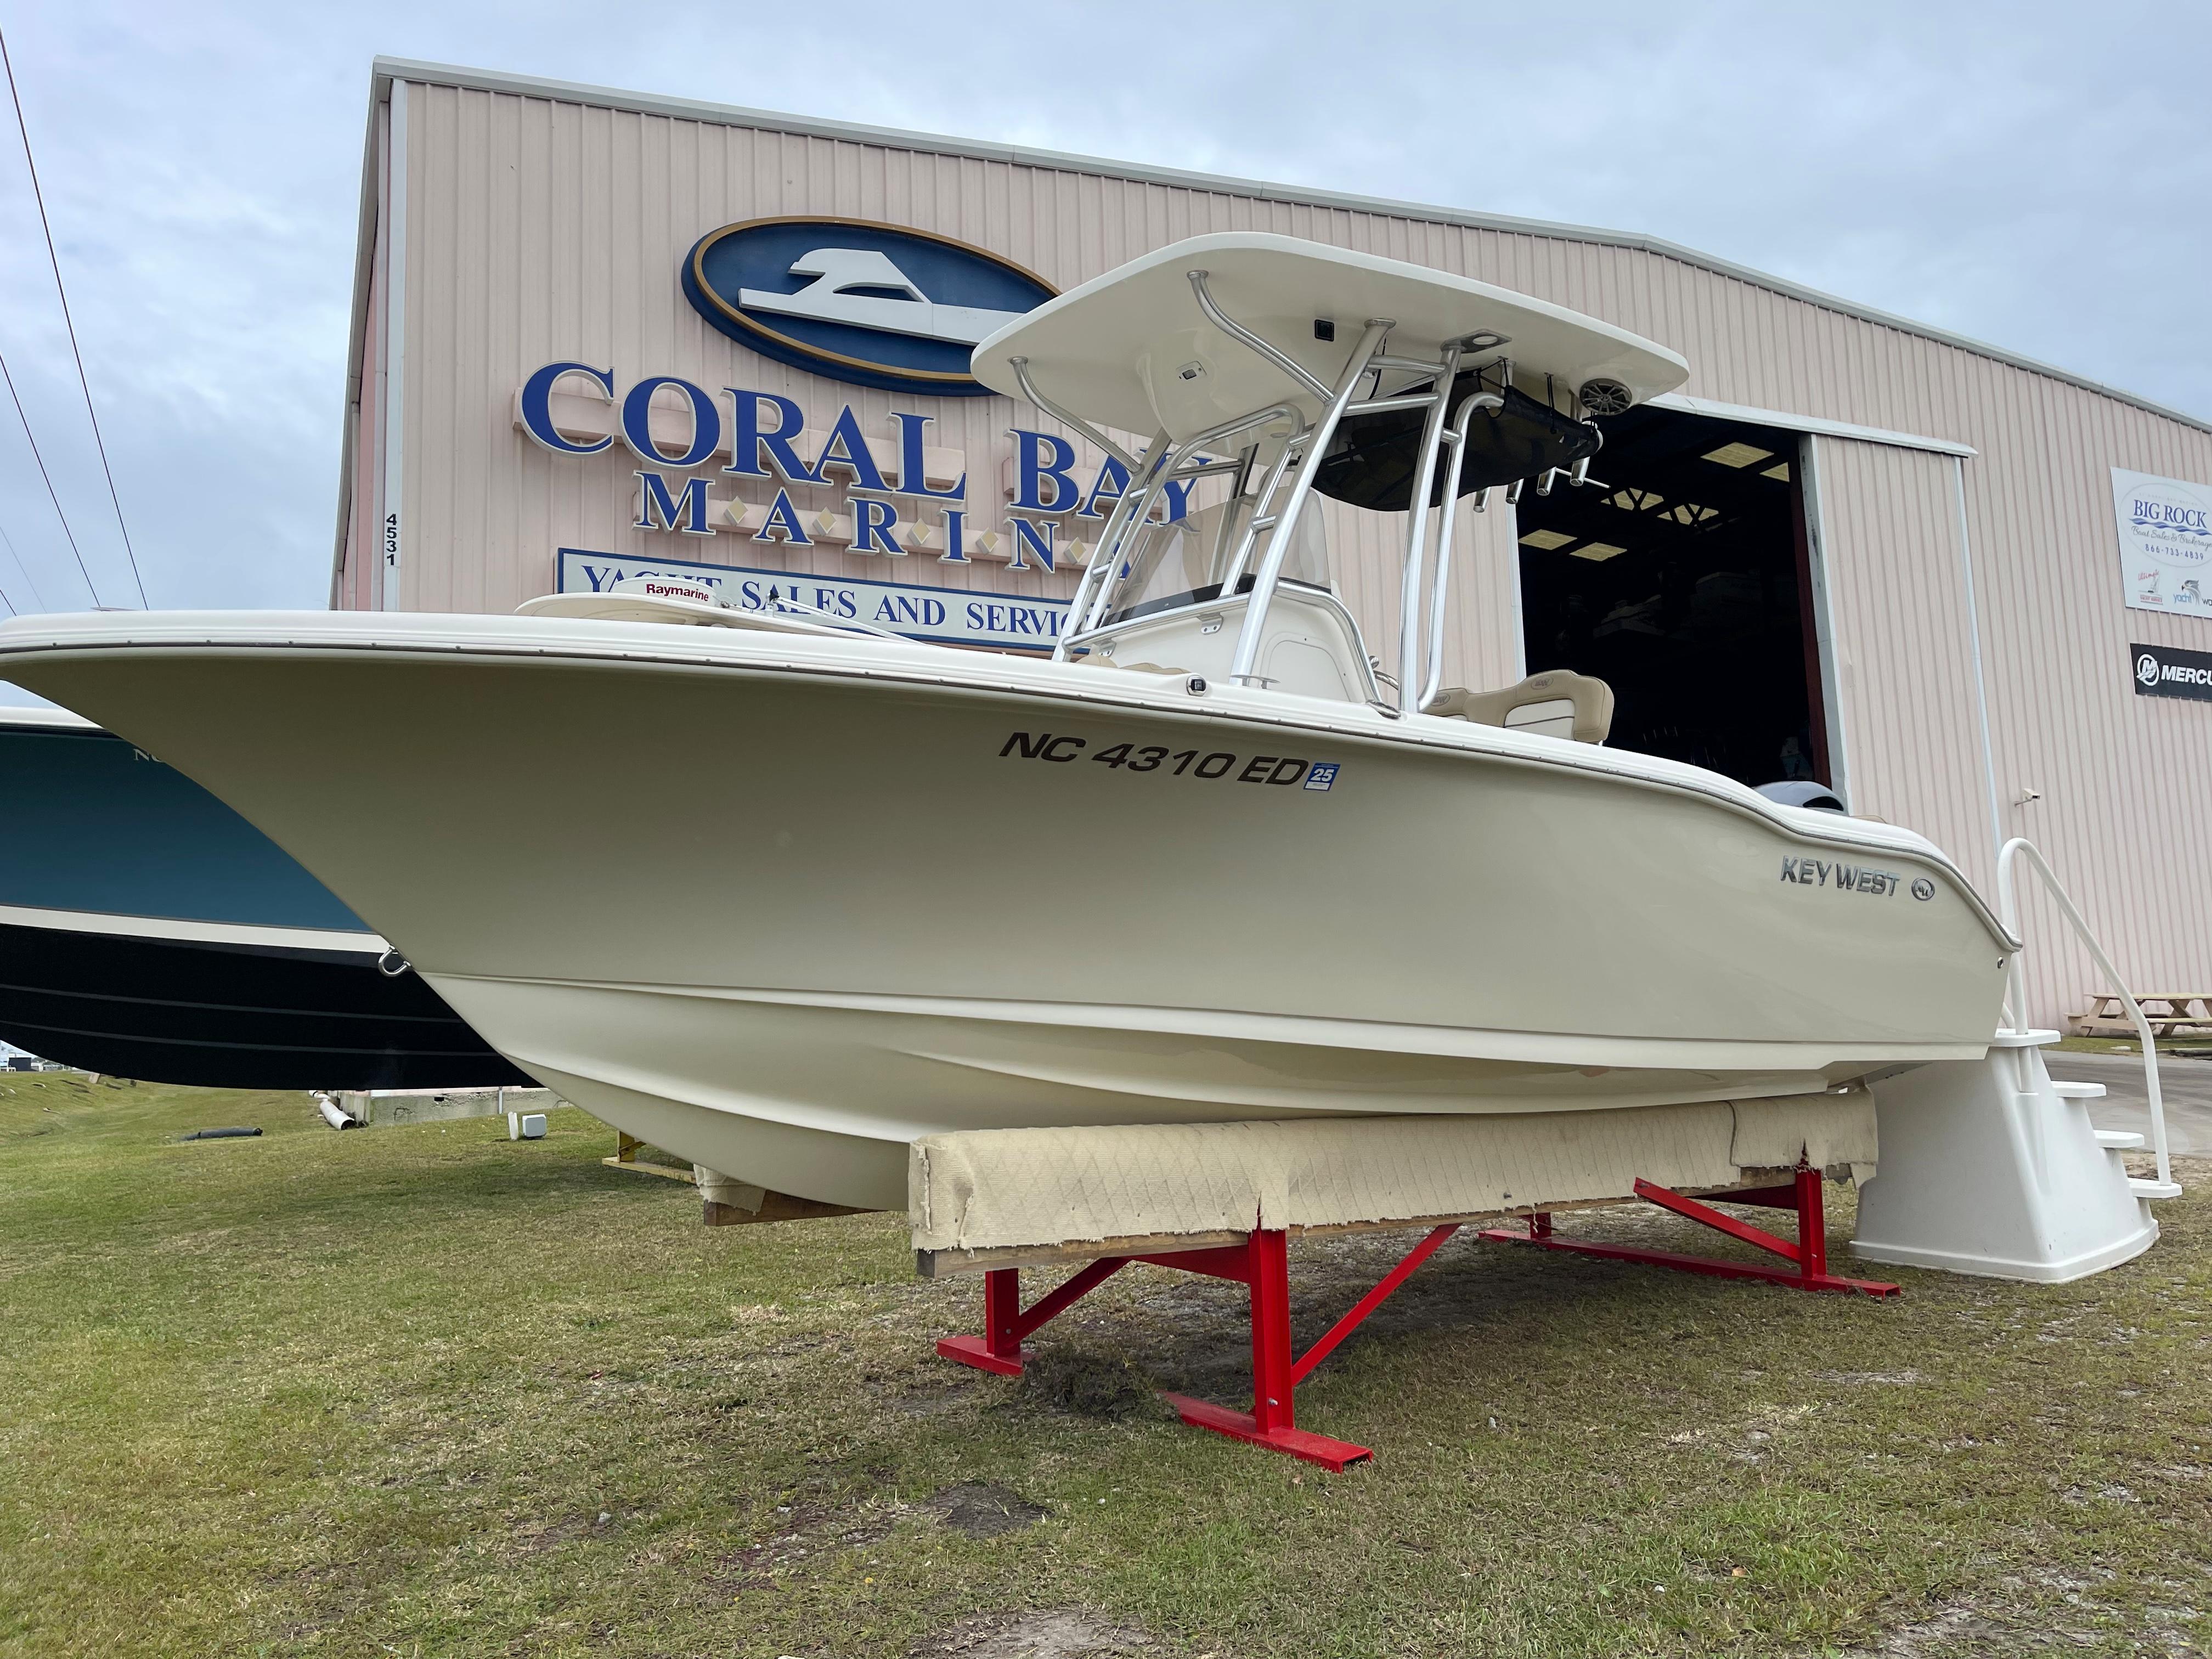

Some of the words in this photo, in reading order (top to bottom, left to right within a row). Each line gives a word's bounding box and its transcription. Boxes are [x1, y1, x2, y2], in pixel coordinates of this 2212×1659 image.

[521, 362, 967, 501] CORAL
[1004, 428, 1214, 527] BAY
[2134, 499, 2160, 520] BIG
[2164, 505, 2207, 528] ROCK
[386, 514, 397, 566] 4531
[2131, 525, 2149, 537] Boat
[2151, 529, 2170, 540] Sales
[2171, 533, 2177, 541] &
[646, 583, 709, 602] Raymarine
[742, 580, 856, 619] SALES
[873, 594, 946, 626] AND
[2173, 593, 2192, 604] yacht
[998, 732, 1086, 763] NC
[1091, 743, 1237, 778] 4310
[1237, 756, 1310, 786] ED
[1310, 768, 1335, 782] 25
[1780, 855, 1832, 886] KEY
[1836, 863, 1901, 896] WEST
